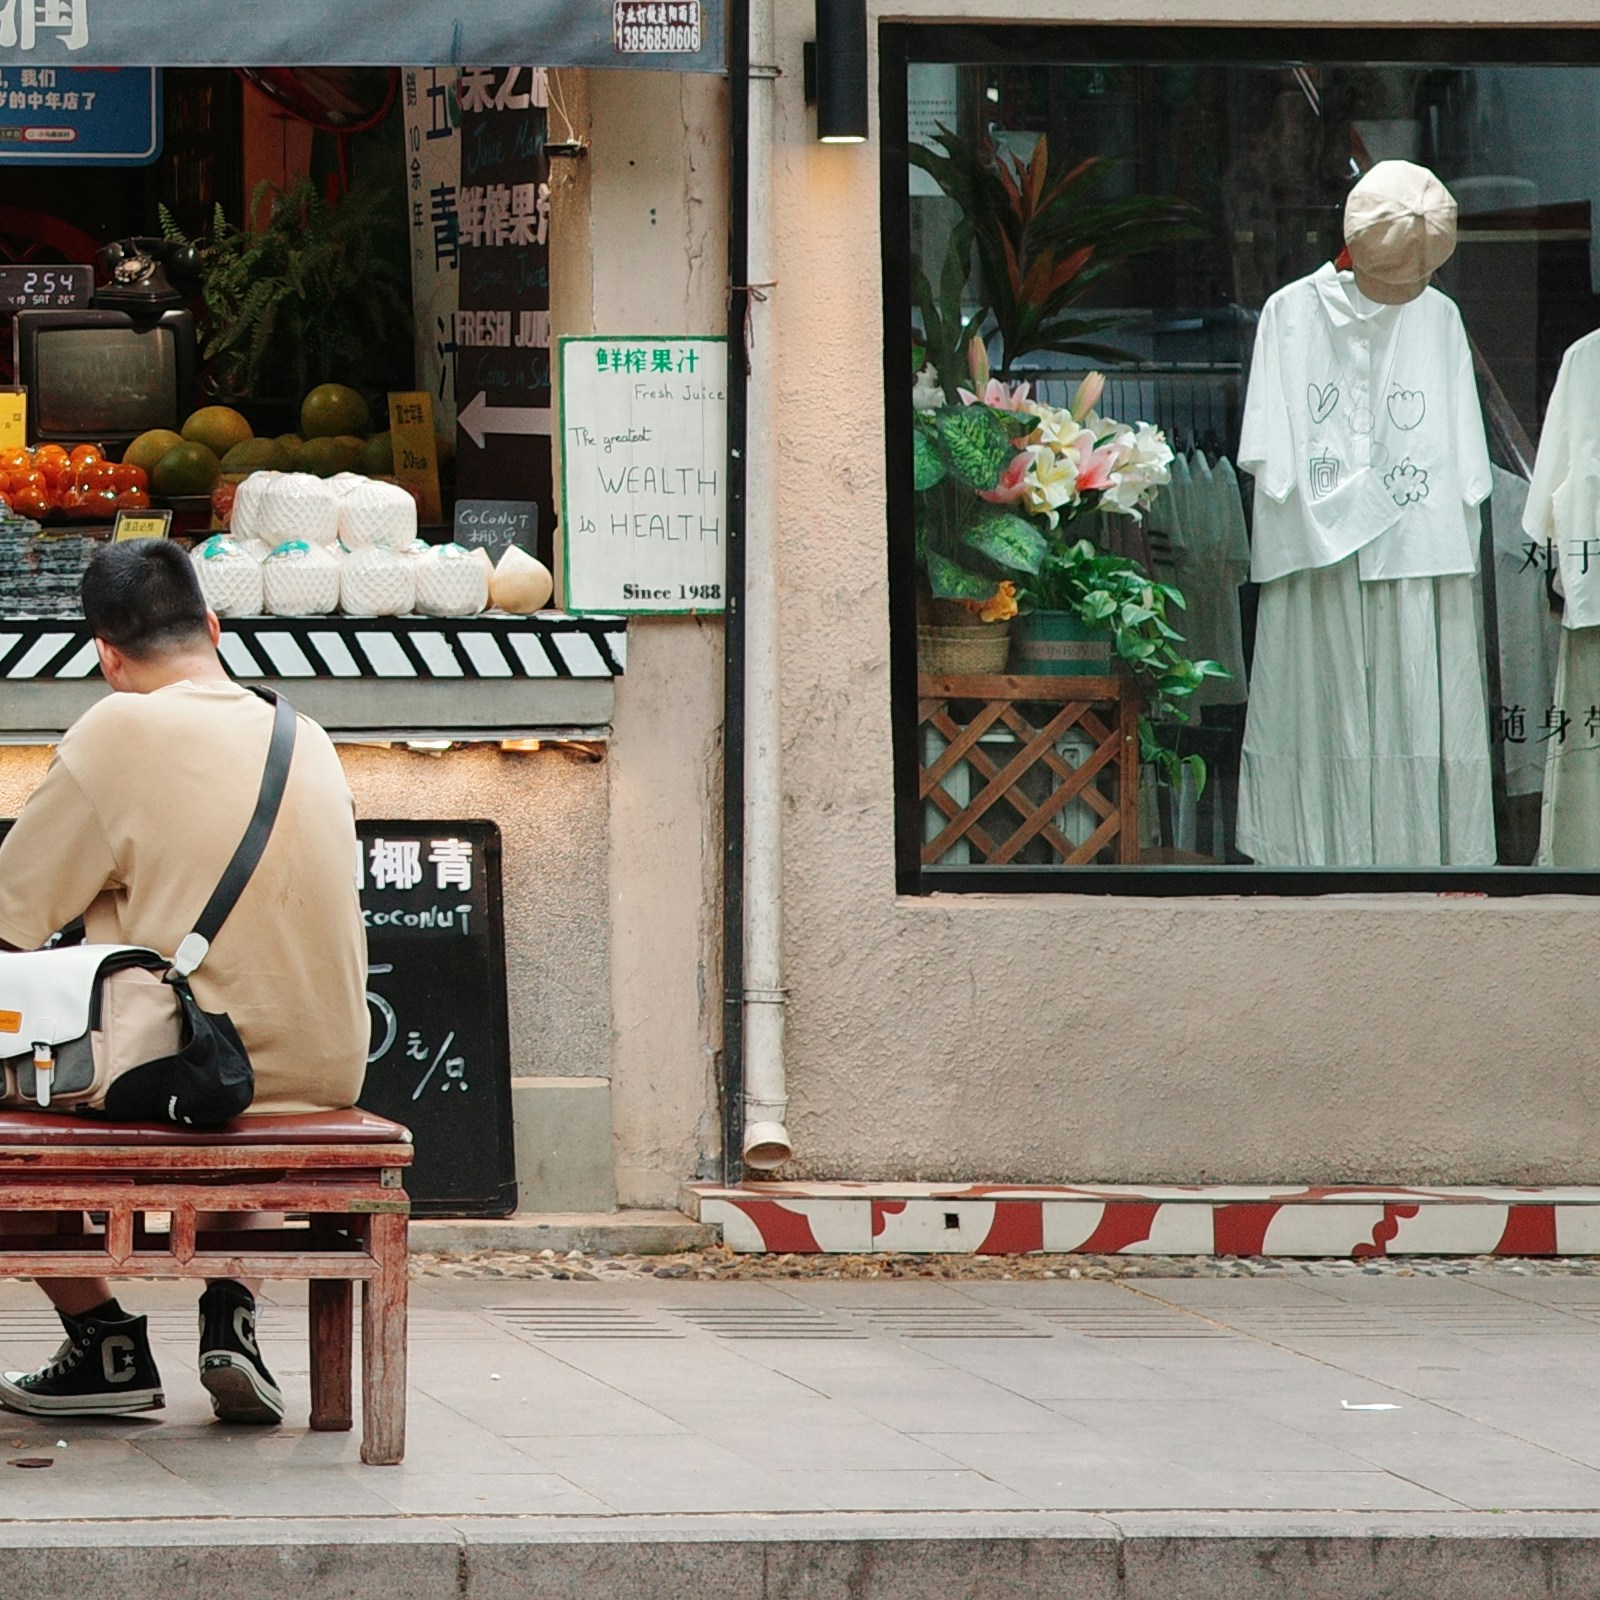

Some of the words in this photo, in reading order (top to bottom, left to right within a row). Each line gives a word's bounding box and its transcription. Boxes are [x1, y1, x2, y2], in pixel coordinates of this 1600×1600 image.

[616, 25, 699, 50] 13856850606
[32, 294, 50, 305] SAT
[455, 310, 512, 347] FRESH
[596, 347, 701, 374] 鲜榨果汁
[634, 382, 674, 401] Fresh
[682, 384, 726, 402] Juice
[569, 426, 597, 447] The
[603, 426, 652, 454] greatest
[597, 466, 717, 496] WEALTH
[611, 513, 719, 545] HEALTH
[622, 583, 673, 601] Since
[677, 583, 722, 601] 1988
